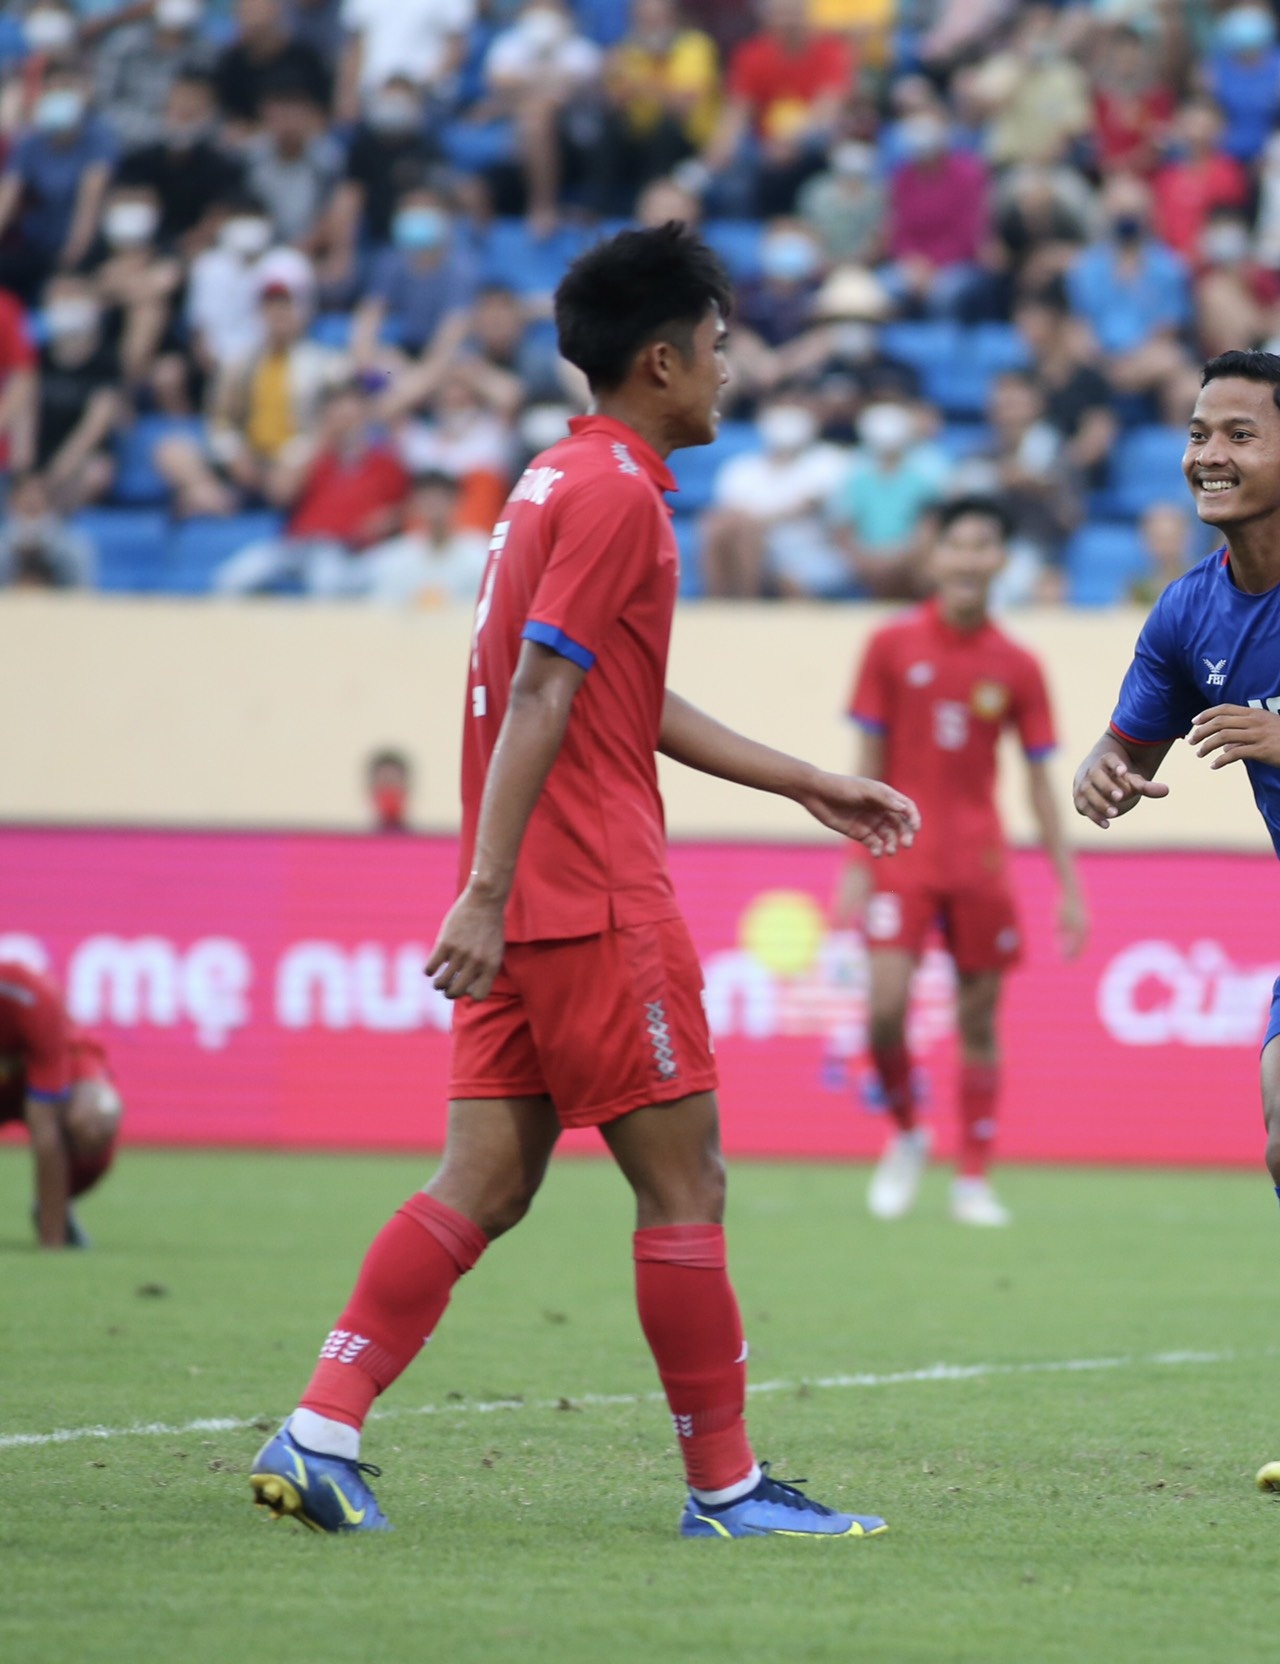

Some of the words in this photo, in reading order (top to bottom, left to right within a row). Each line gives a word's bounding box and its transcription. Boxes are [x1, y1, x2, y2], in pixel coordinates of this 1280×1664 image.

[1206, 673, 1227, 686] FBT
[68, 934, 249, 1051] mẹ
[276, 940, 453, 1032] nu
[1098, 938, 1278, 1046] Cù
